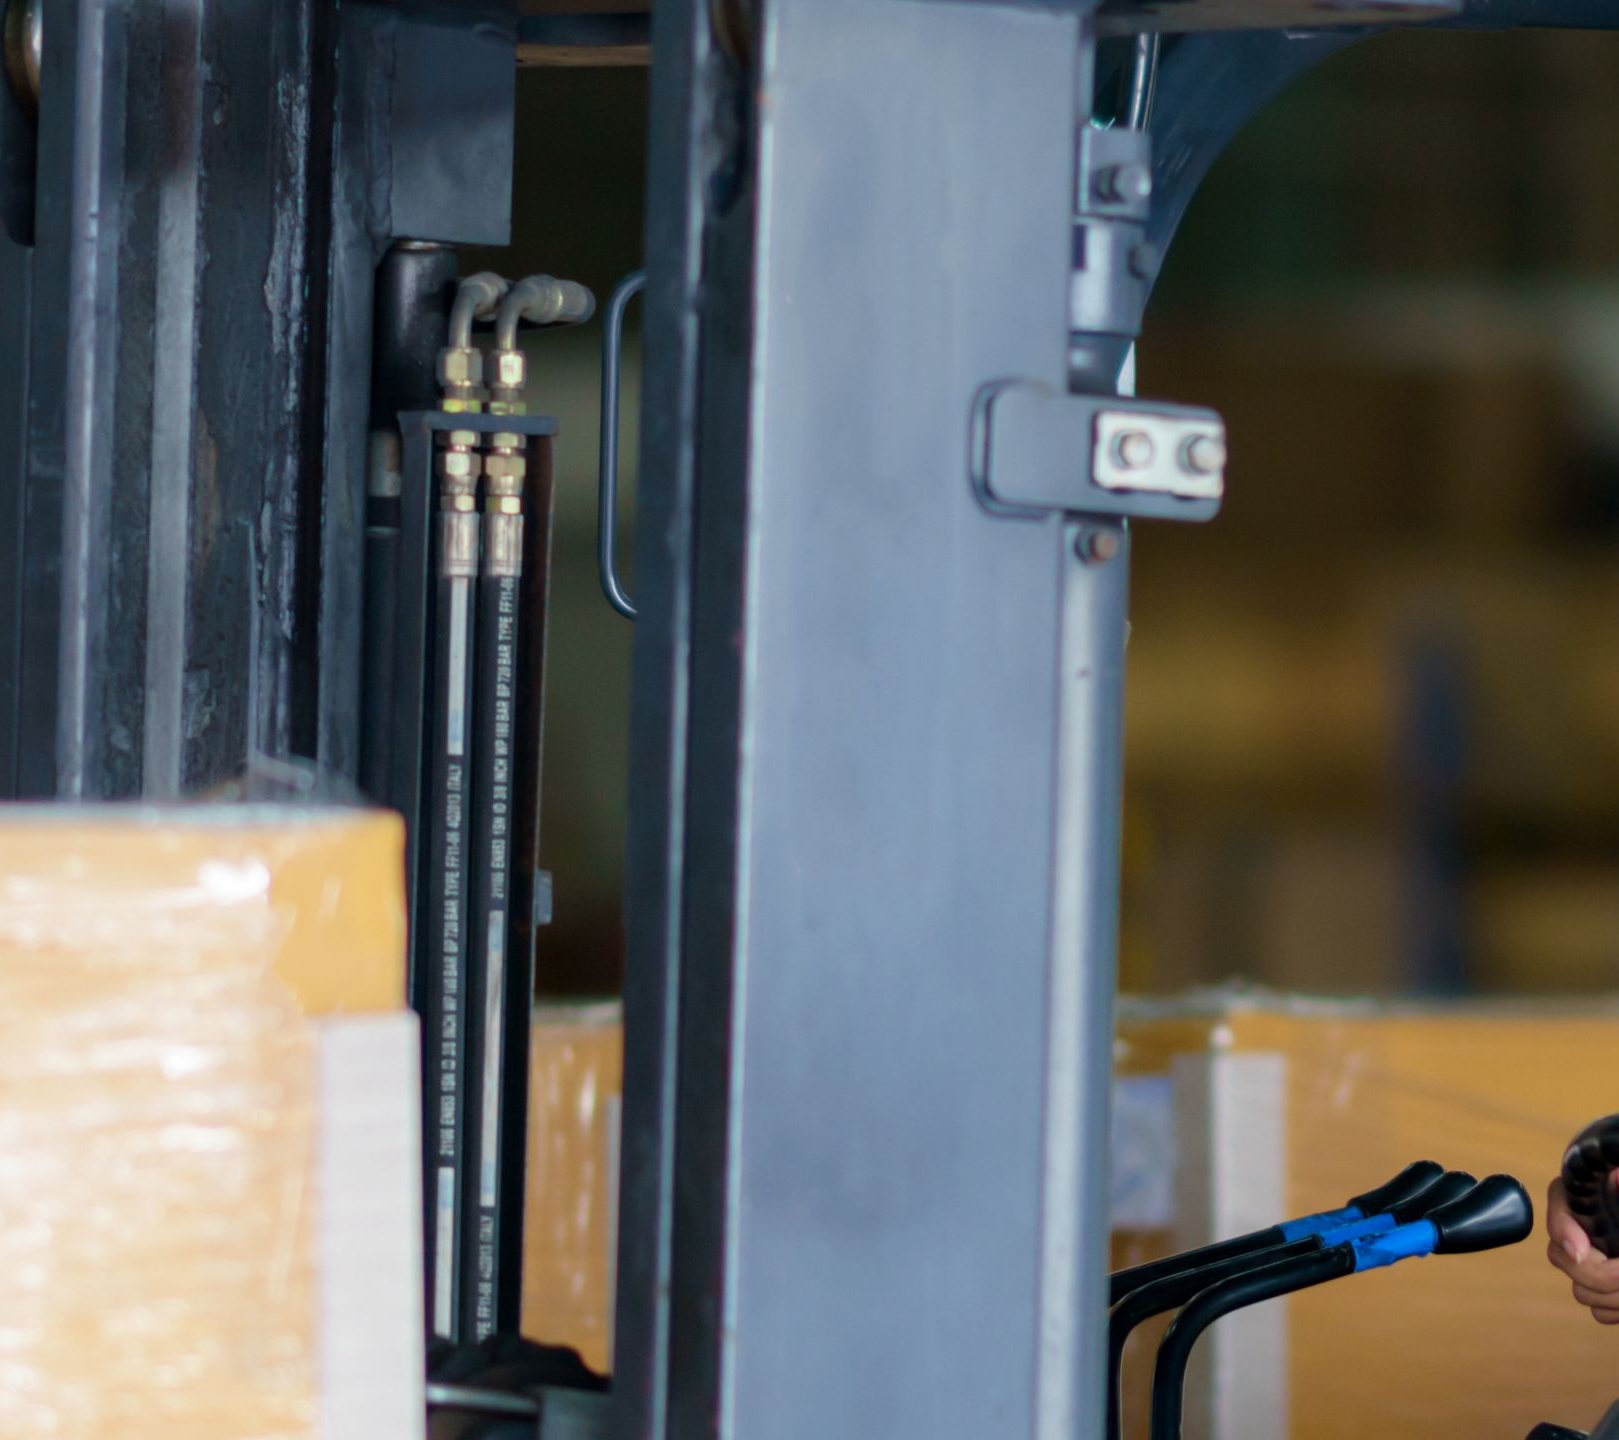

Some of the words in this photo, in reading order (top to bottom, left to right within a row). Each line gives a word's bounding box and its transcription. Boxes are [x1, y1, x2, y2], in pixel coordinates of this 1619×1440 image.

[497, 616, 513, 641] TYPE
[496, 644, 513, 665] BAR
[496, 666, 512, 683] 720
[495, 683, 512, 698] BP
[495, 700, 511, 722] BAR
[494, 739, 510, 756] WP
[446, 765, 462, 791] ITALY
[493, 758, 509, 783] INCH
[444, 872, 461, 897] TYPE
[443, 900, 460, 921] BAR
[442, 956, 459, 978] BAR
[441, 1015, 458, 1039] INCH
[476, 1322, 493, 1344] YPE
